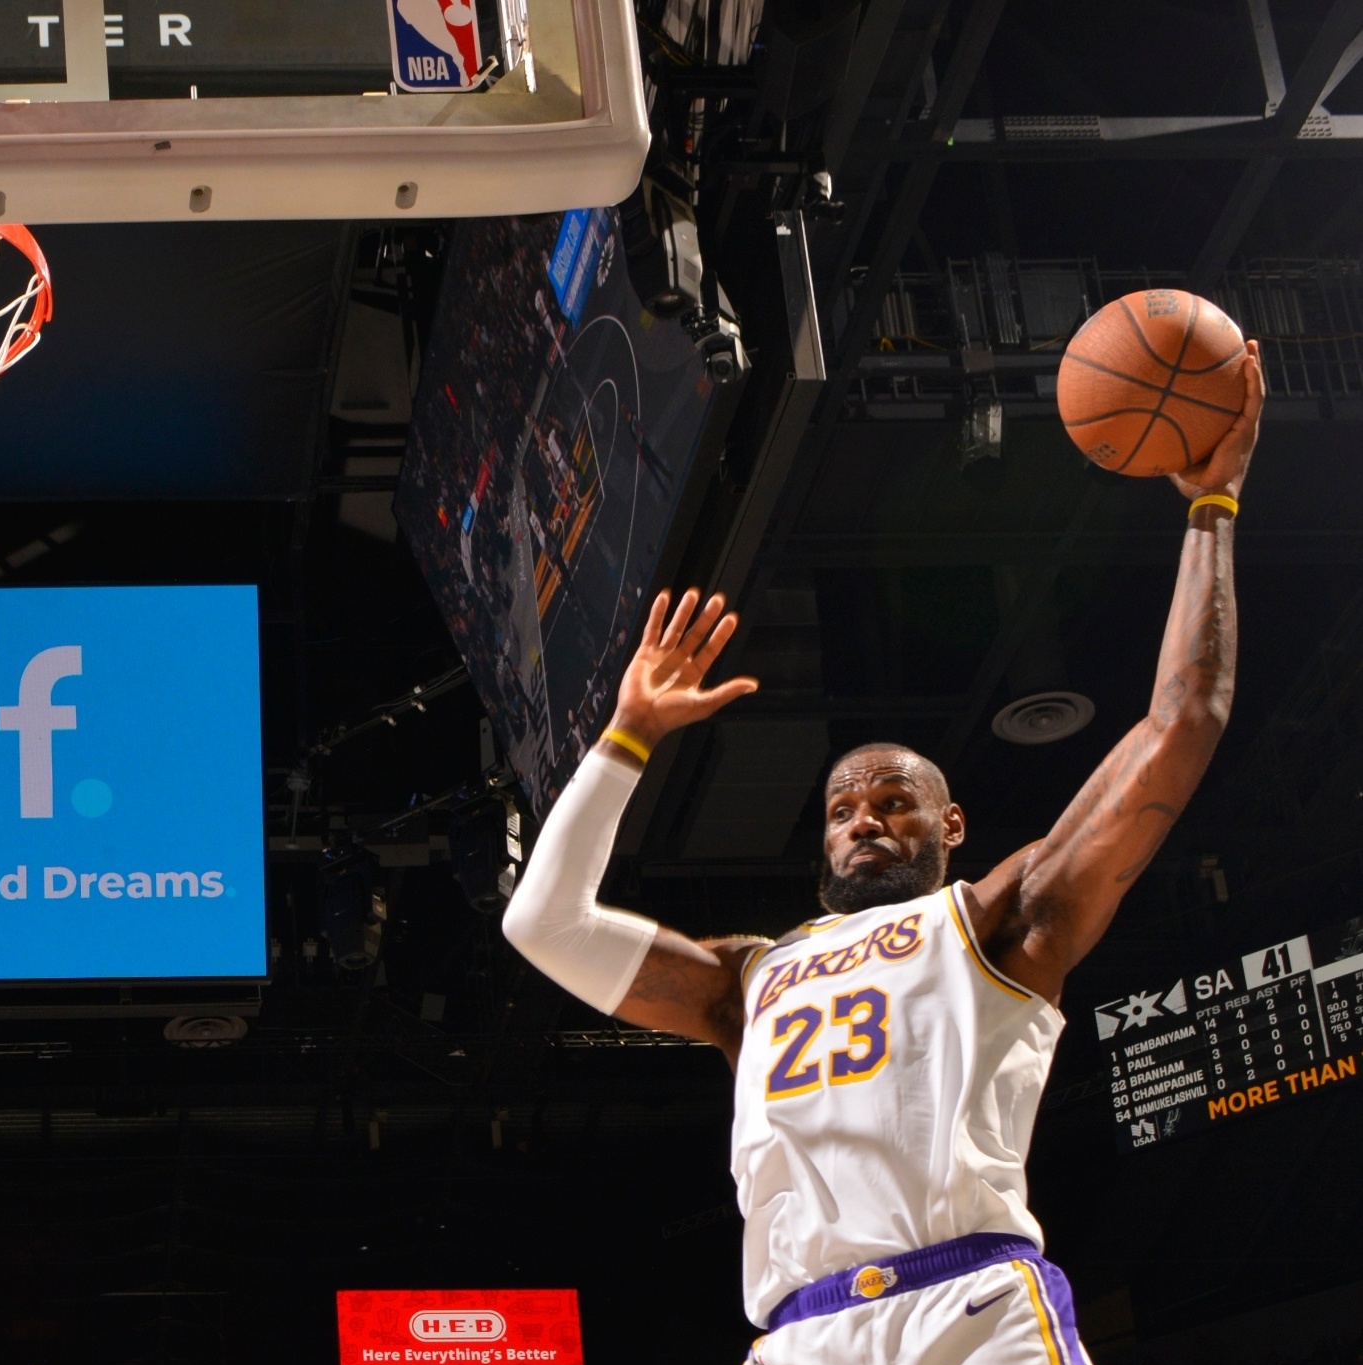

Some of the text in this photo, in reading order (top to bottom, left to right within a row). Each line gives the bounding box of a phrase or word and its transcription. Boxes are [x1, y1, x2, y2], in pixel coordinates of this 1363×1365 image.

[407, 55, 451, 83] NBA
[751, 913, 925, 1030] LAKERS
[1194, 943, 1293, 1000] SA 41
[1196, 975, 1306, 1021] PTS REB AST PF
[765, 986, 891, 1102] 23
[1112, 1004, 1307, 1077] 3 PAUL 3 0 5 0
[1124, 1025, 1197, 1058] WEMBANYAMA
[1204, 1018, 1217, 1030] 14
[1236, 1009, 1245, 1019] 4
[1266, 999, 1275, 1010] 2
[1296, 989, 1302, 1000] 1
[1111, 1019, 1310, 1094] 22 BRANHAM 3 0 0 0
[1113, 1034, 1313, 1108] 30 CHAMPAGNIE 5 5 0 0
[1208, 1056, 1356, 1120] MORE THAN
[1115, 1109, 1131, 1123] 54
[1217, 1079, 1226, 1090] 0
[1246, 1069, 1256, 1080] 2
[1277, 1059, 1286, 1070] 0
[1133, 1134, 1156, 1148] USAA
[363, 1348, 557, 1365] Here Everything's Better
